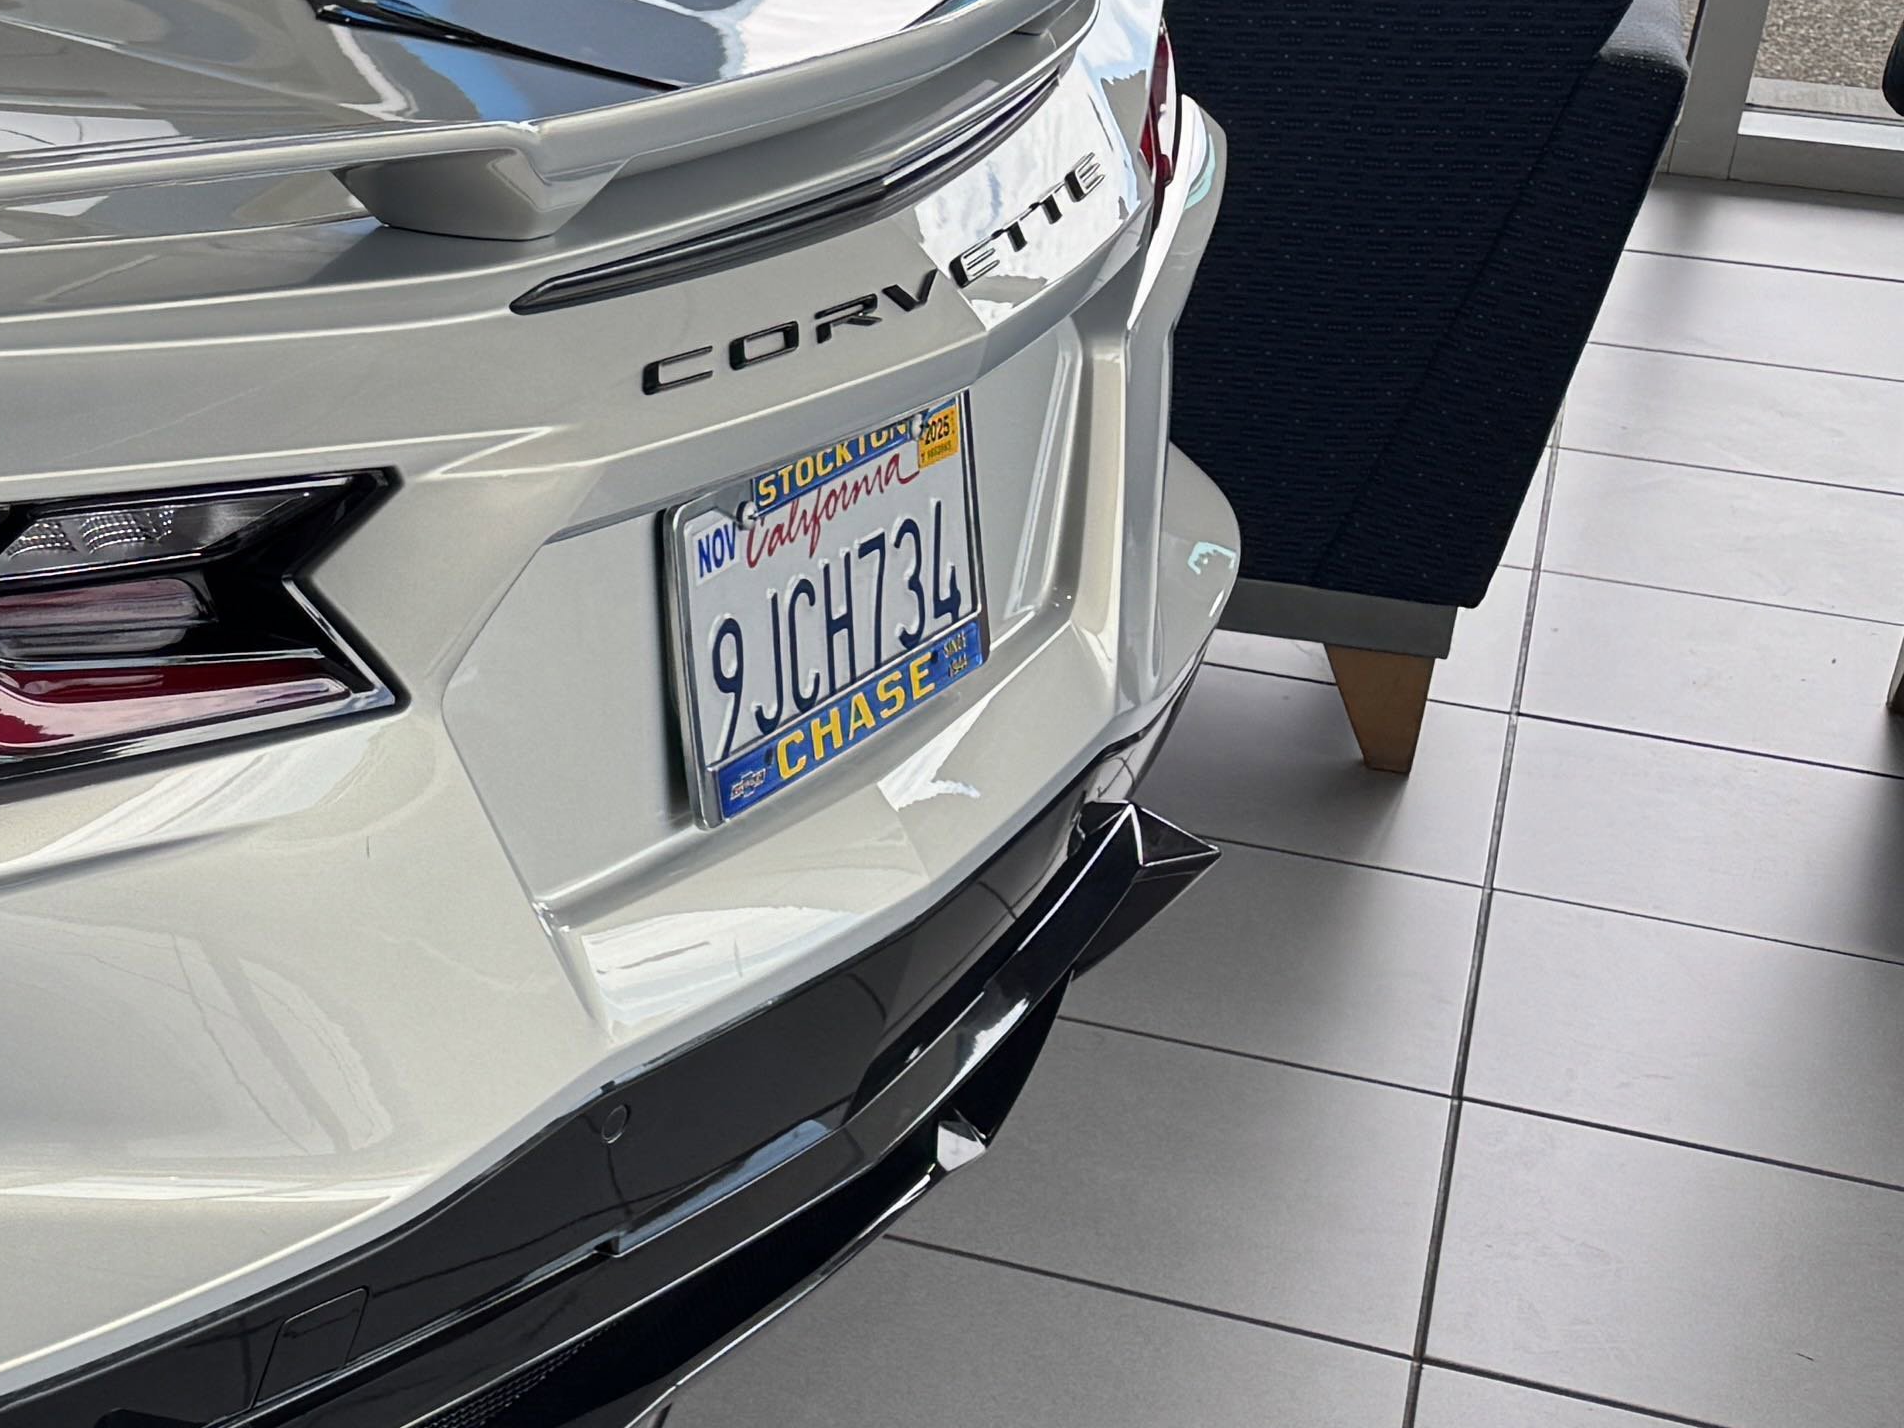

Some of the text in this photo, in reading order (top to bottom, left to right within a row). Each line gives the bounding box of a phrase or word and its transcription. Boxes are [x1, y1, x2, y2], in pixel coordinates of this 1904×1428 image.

[642, 152, 1106, 395] CORVETTE
[924, 414, 951, 445] 2025
[697, 521, 738, 578] NOV
[746, 451, 920, 568] California
[711, 499, 962, 760] 9JCH734
[776, 651, 936, 780] CHASE
